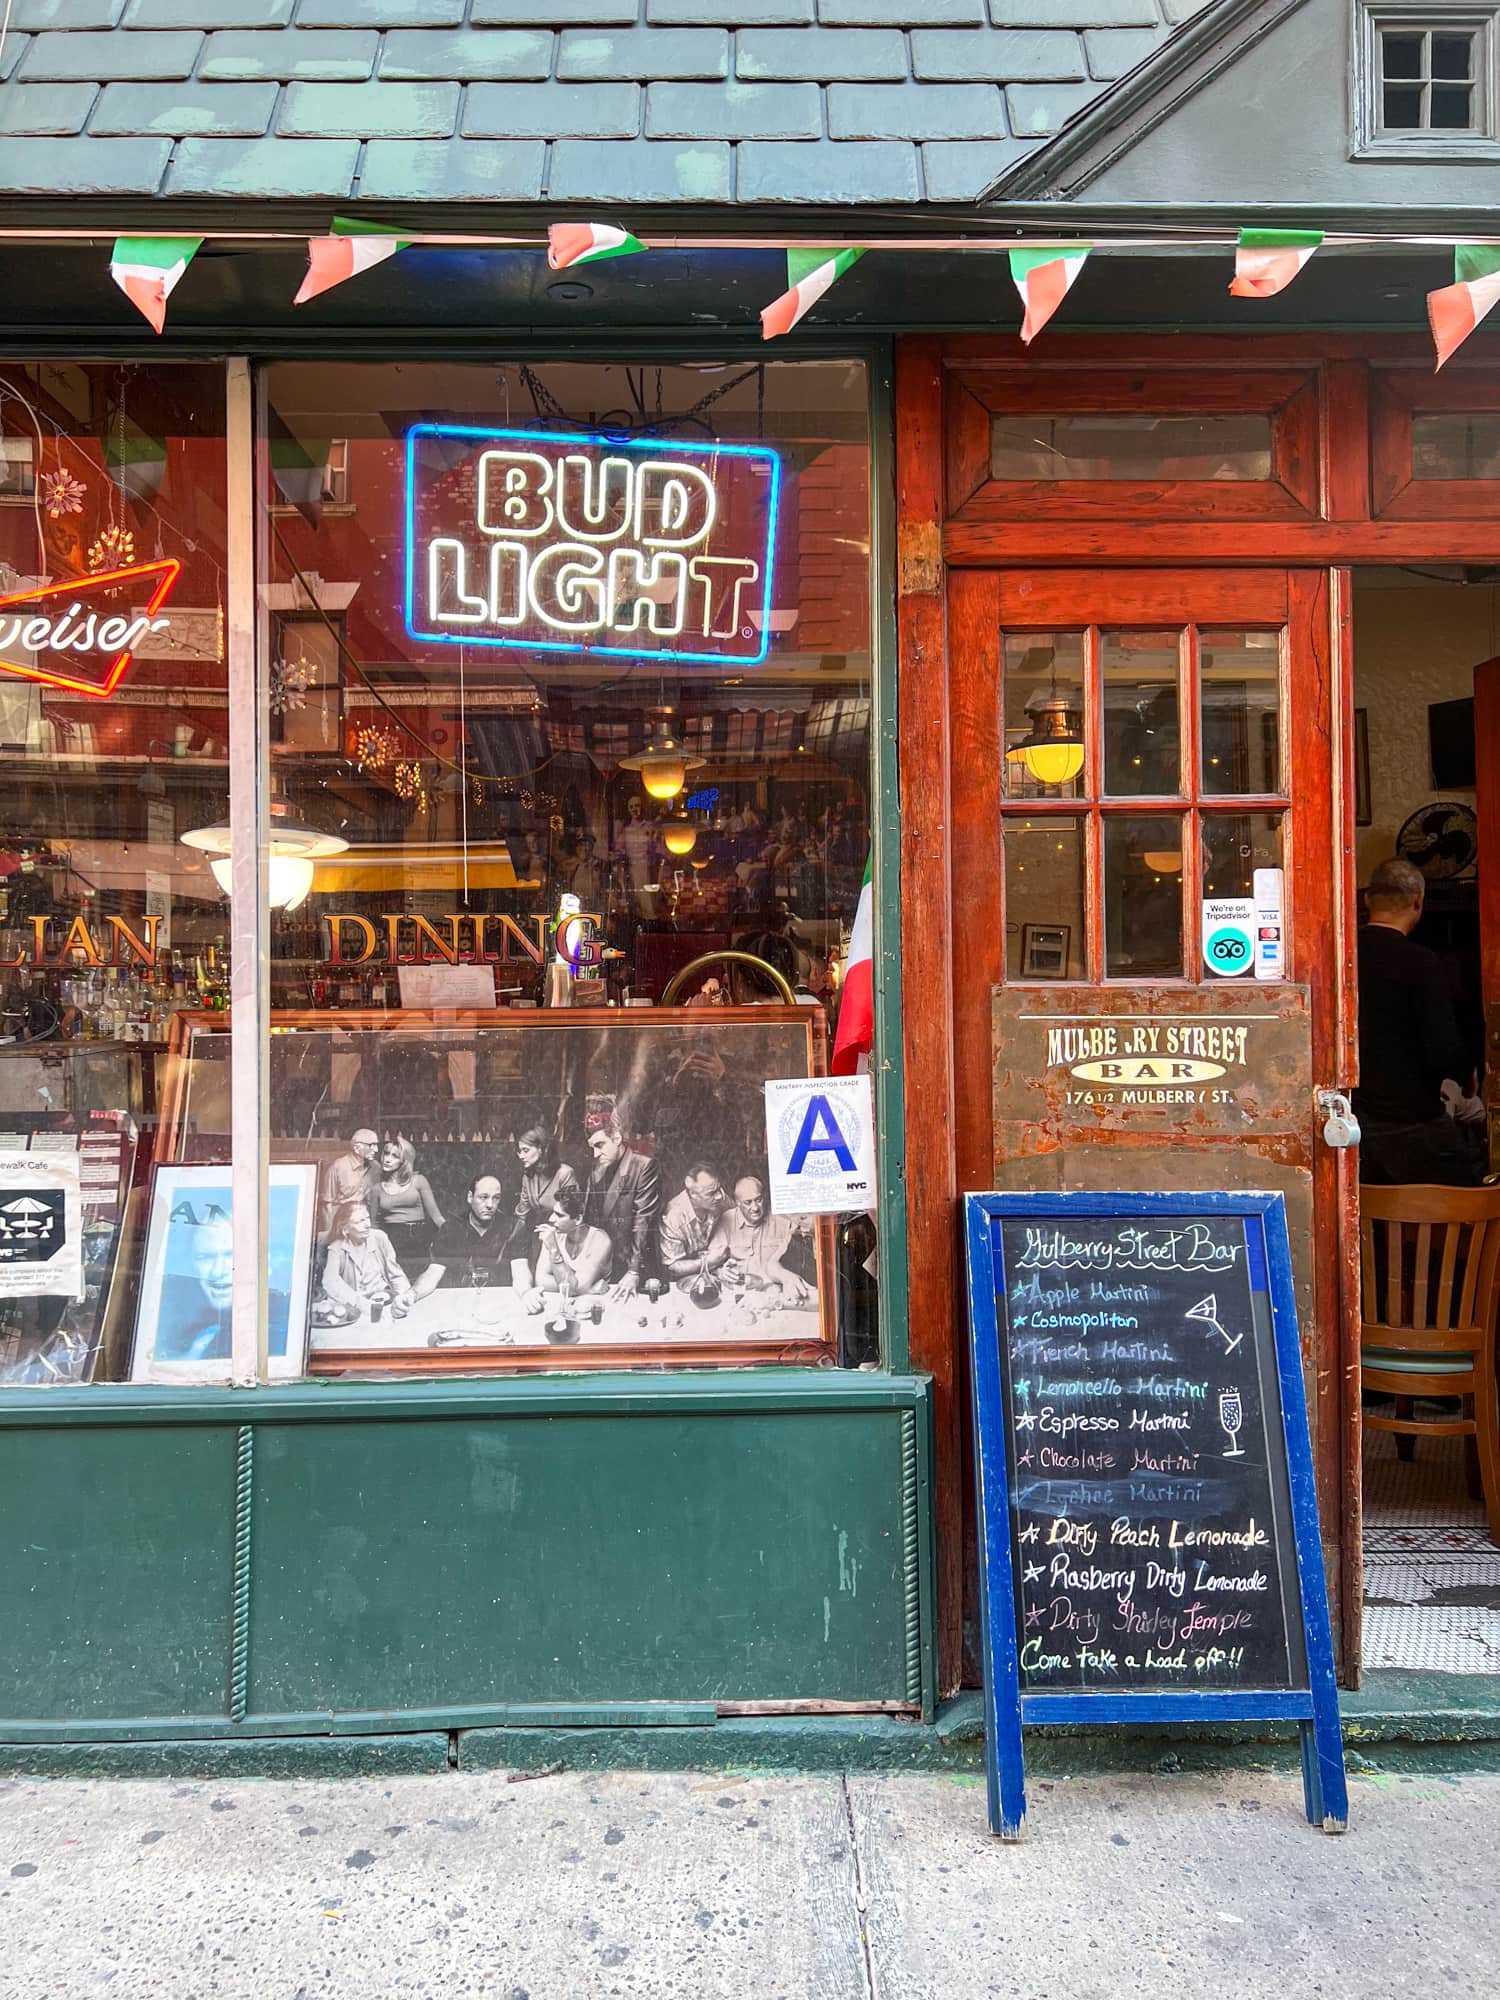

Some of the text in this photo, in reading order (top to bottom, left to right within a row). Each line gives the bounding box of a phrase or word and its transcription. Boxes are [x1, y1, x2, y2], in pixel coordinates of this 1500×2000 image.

[477, 449, 717, 547] BUD
[428, 537, 760, 639] LIGHT
[1205, 912, 1251, 921] Tripadvisor
[322, 911, 606, 967] DINING
[1047, 1026, 1248, 1068] MULBERY STREET
[1100, 1062, 1194, 1079] BAR
[1066, 1091, 1094, 1105] 176
[1098, 1093, 1114, 1103] 1/2
[1212, 1090, 1234, 1104] ST.
[786, 1094, 858, 1175] A
[846, 1181, 868, 1191] NYC
[1113, 1227, 1192, 1262] Street
[1184, 1223, 1248, 1262] Bar
[1030, 1273, 1080, 1308] Apple
[1031, 1311, 1139, 1336] Cosmopolitan
[1039, 1406, 1120, 1439] Espresso
[1040, 1447, 1200, 1471] Chocolate Martini
[1130, 1483, 1203, 1502] Martini
[1110, 1516, 1160, 1548] Peach
[1168, 1517, 1270, 1551] Lemonade
[1049, 1552, 1268, 1602] Rasberry Dirty Lemonade
[1049, 1596, 1253, 1650] Dirty Shirley Temple
[1020, 1635, 1072, 1671] Come
[1124, 1655, 1141, 1668] a
